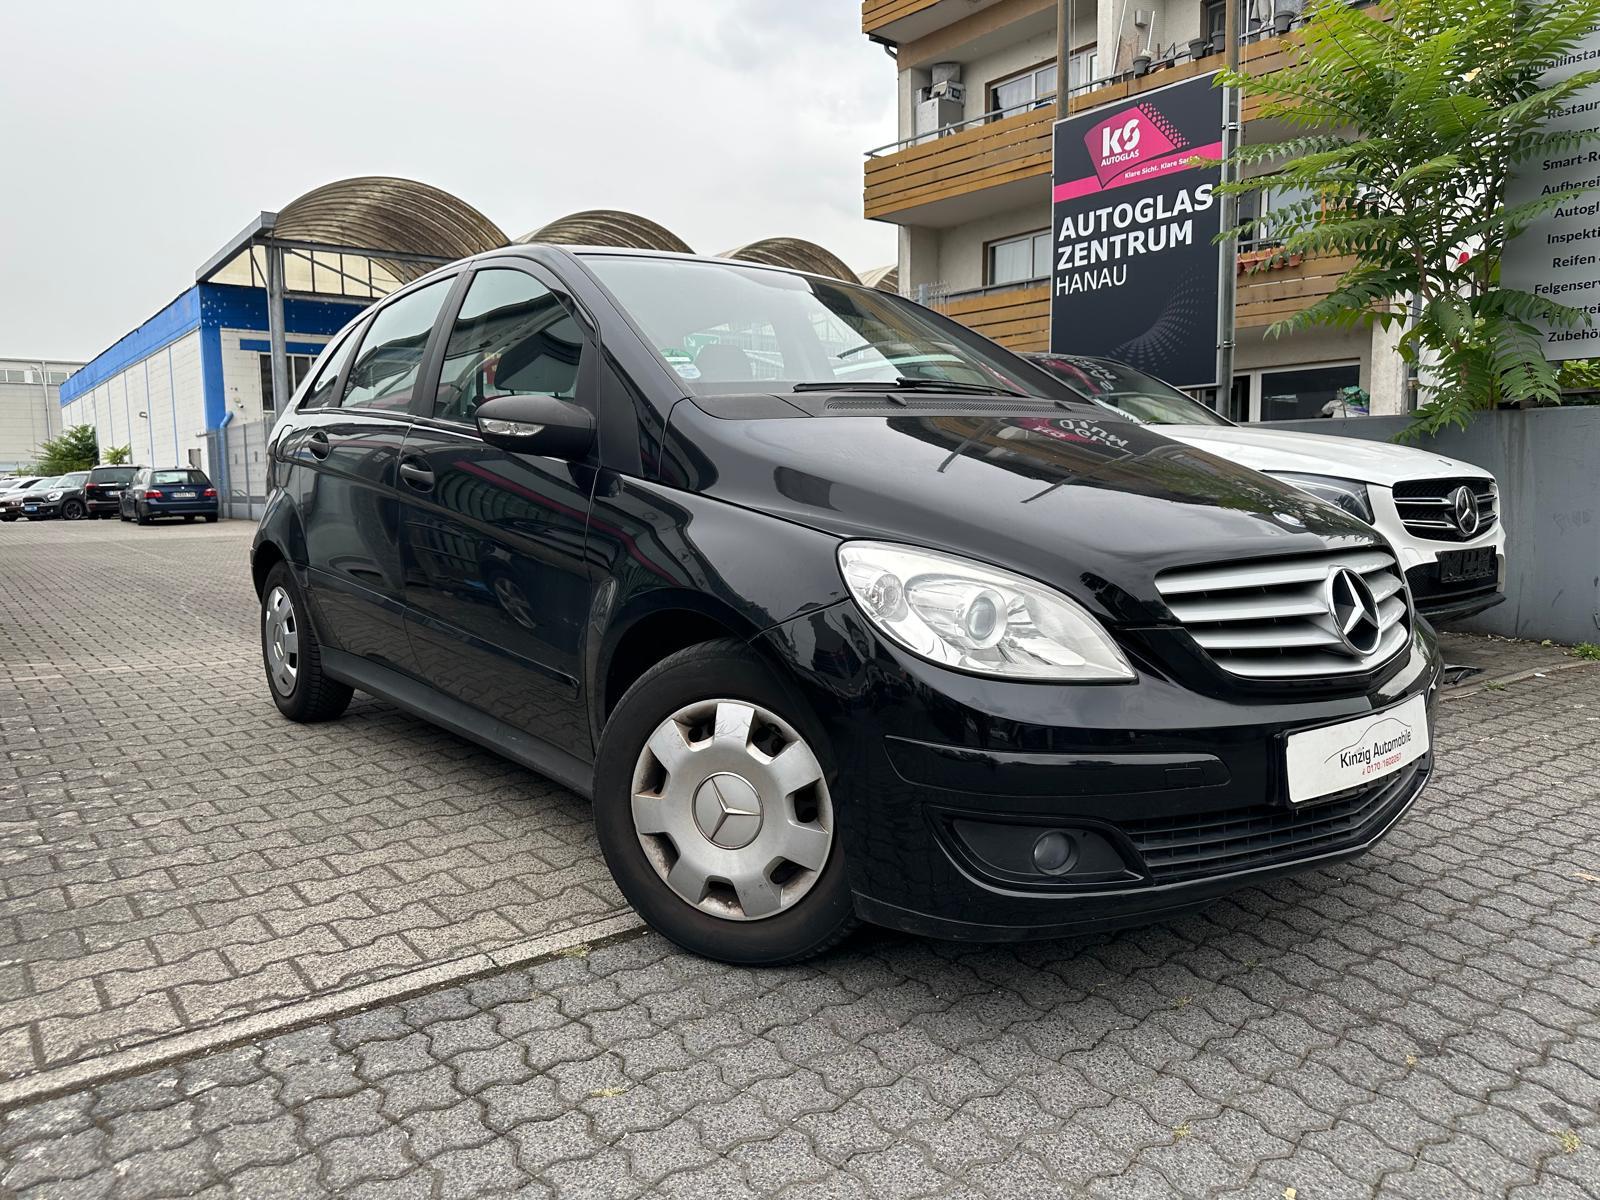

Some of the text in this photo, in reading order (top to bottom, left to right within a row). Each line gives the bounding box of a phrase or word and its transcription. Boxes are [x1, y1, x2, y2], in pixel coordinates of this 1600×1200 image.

[1100, 149, 1140, 167] AUTOGLAS
[1124, 170, 1140, 179] Klare
[1141, 166, 1159, 175] Sicht.
[1160, 161, 1178, 170] Klare
[1058, 184, 1214, 241] AUTOGLAS
[1554, 201, 1600, 218] Autogl
[1057, 219, 1193, 270] ZENTRUM
[1552, 254, 1596, 268] Reifen
[1056, 264, 1127, 297] HANAU
[1547, 328, 1600, 342] Zubehö
[1340, 729, 1412, 768] Kinzig Automobile
